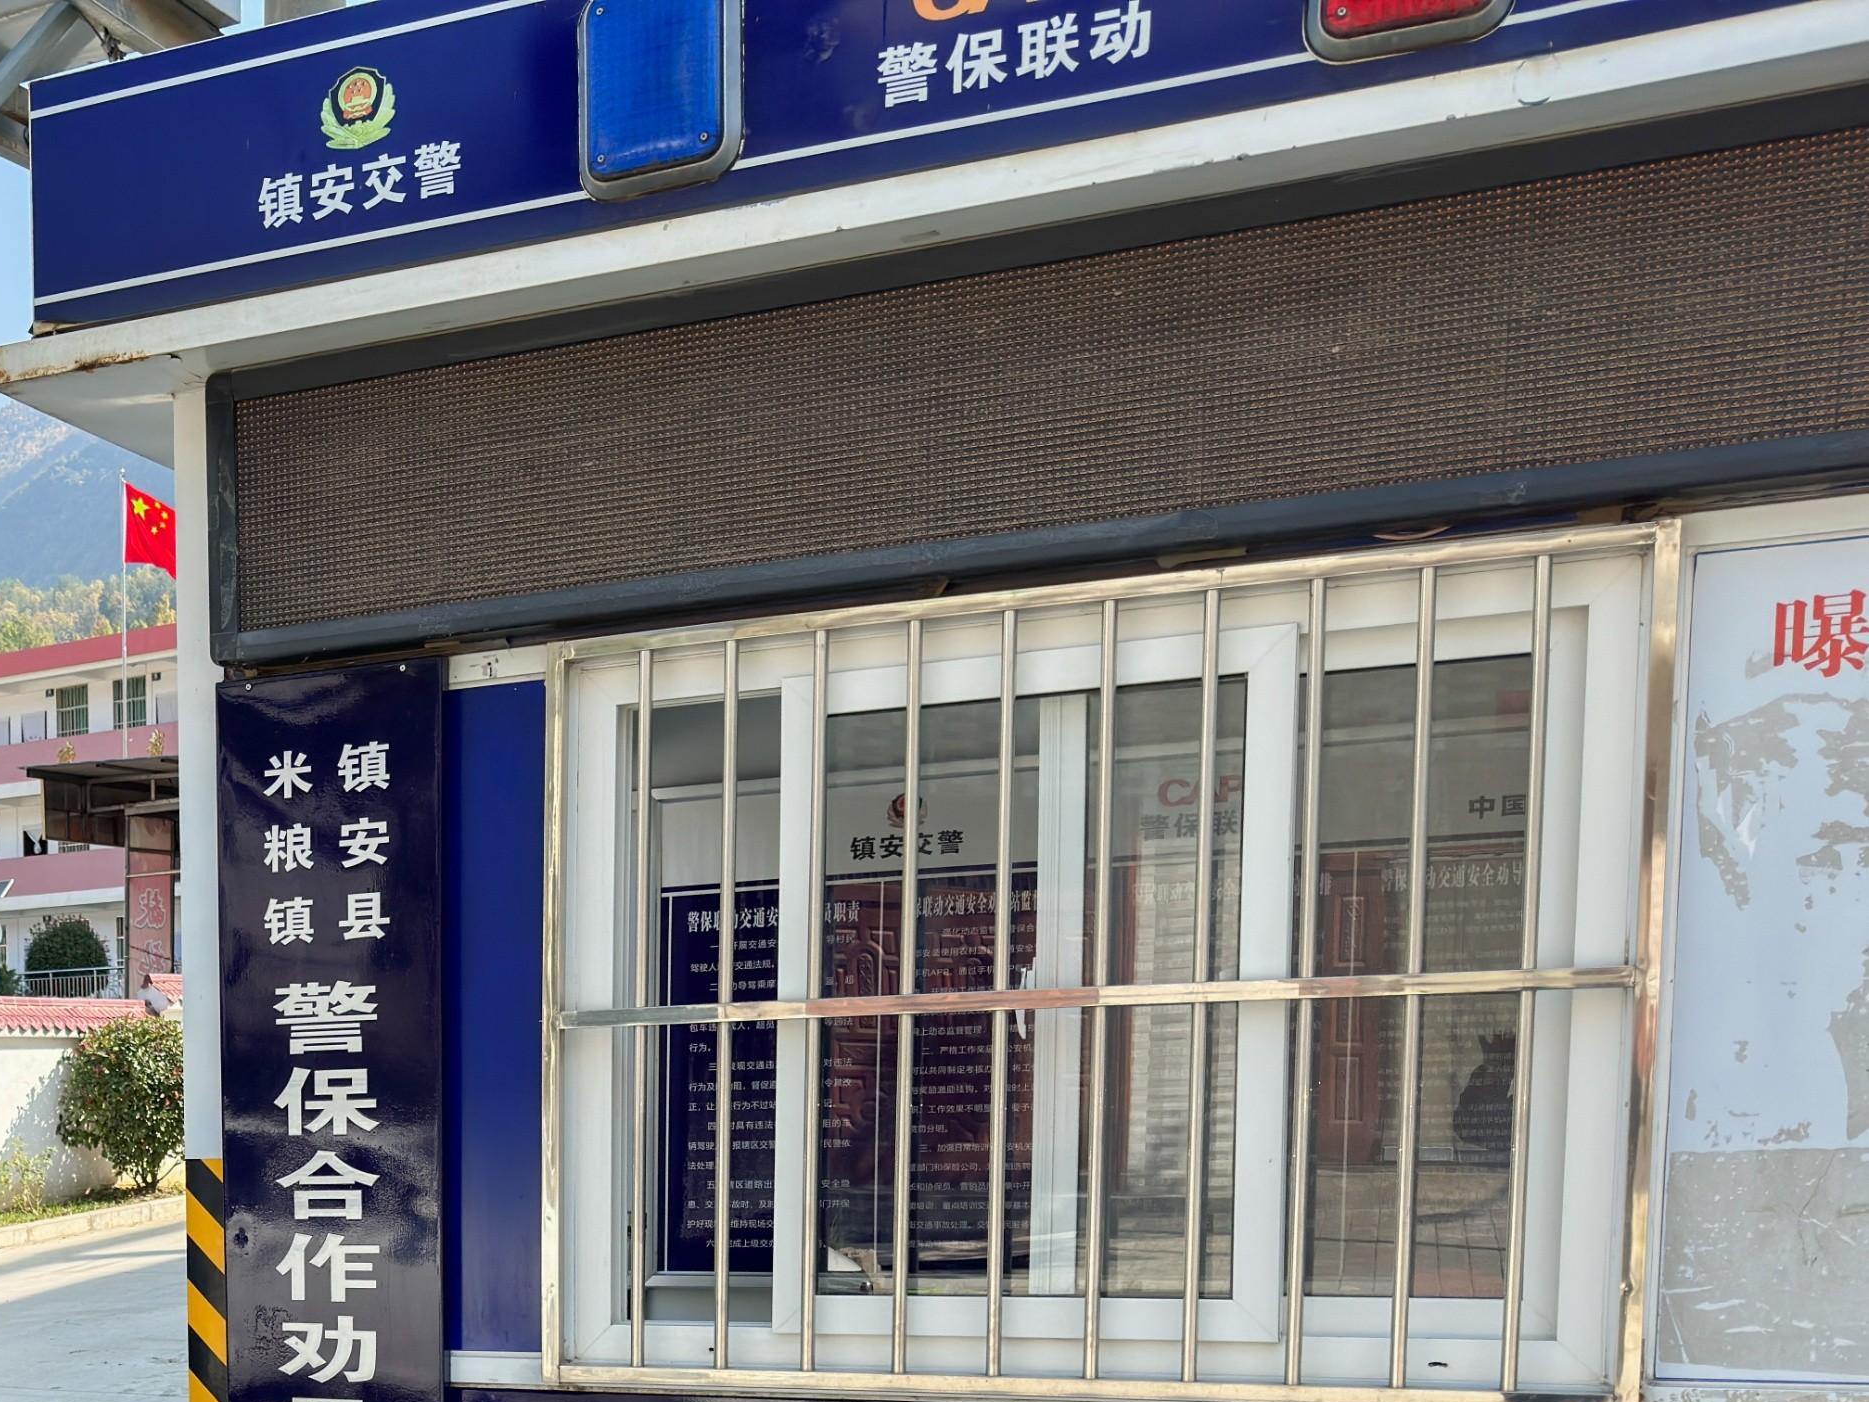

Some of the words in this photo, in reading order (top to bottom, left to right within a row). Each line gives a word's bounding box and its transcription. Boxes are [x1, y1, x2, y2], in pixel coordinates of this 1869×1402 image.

[877, 3, 1152, 108] 警保联动
[258, 140, 461, 229] 镇安交警
[1773, 589, 1869, 678] 曝
[263, 750, 314, 946] 米粮镇
[337, 741, 391, 940] 镇安县
